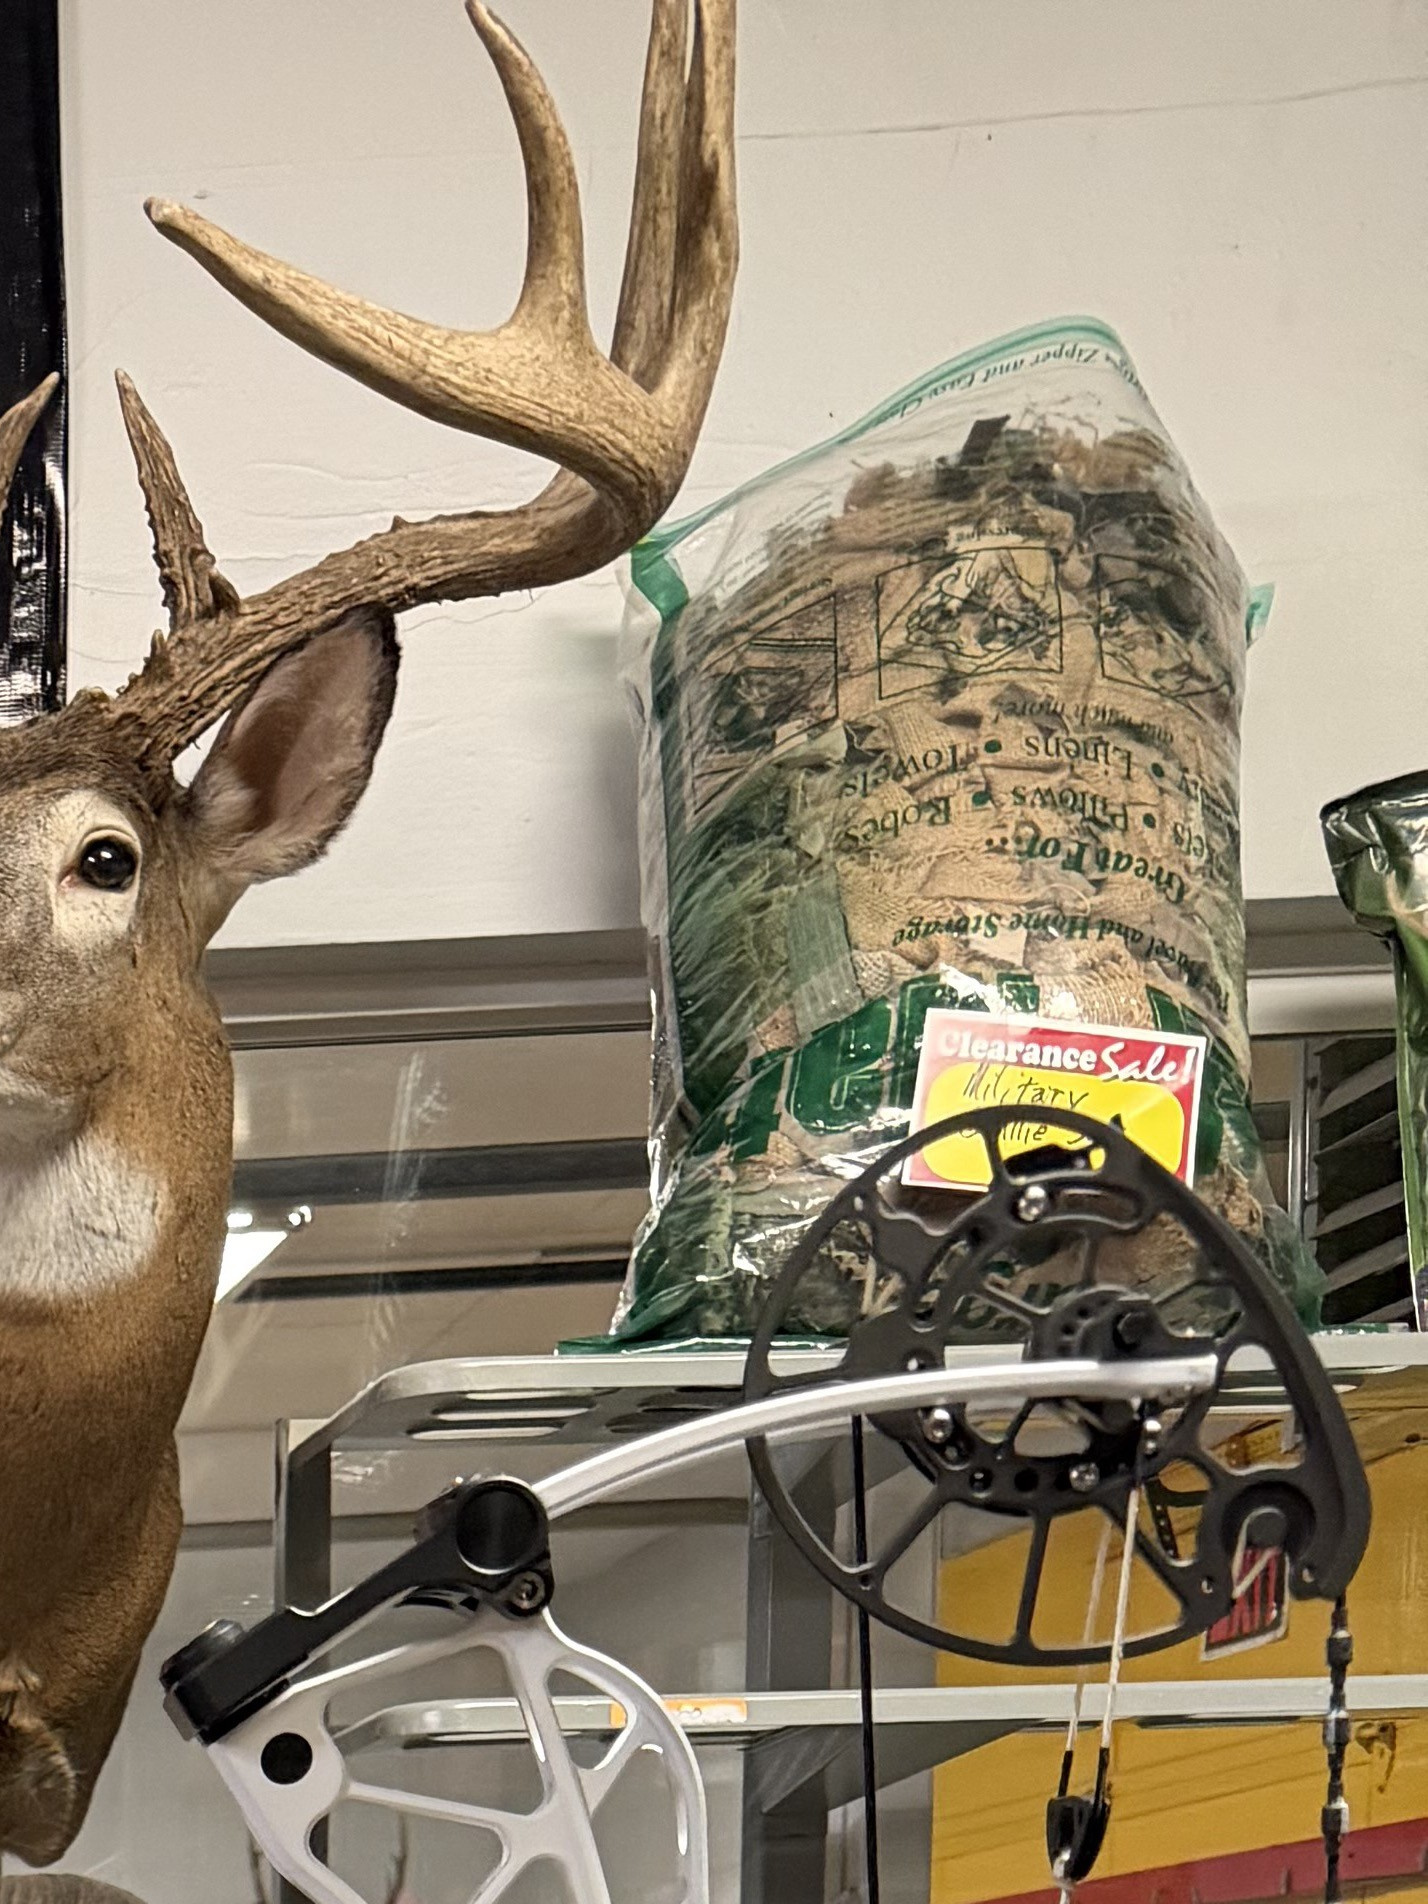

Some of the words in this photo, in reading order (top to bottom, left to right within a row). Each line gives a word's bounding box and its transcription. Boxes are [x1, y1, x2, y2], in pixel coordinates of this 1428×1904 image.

[843, 743, 969, 797] Towels
[1024, 733, 1133, 781] Linens
[844, 795, 952, 844] Robes
[1012, 784, 1130, 833] Pillows
[1095, 842, 1186, 903] Great
[891, 911, 1000, 948] Storage
[1009, 910, 1091, 942] Home
[1095, 915, 1145, 946] and
[937, 1028, 1098, 1072] Clearance
[1098, 1040, 1197, 1084] Sale!
